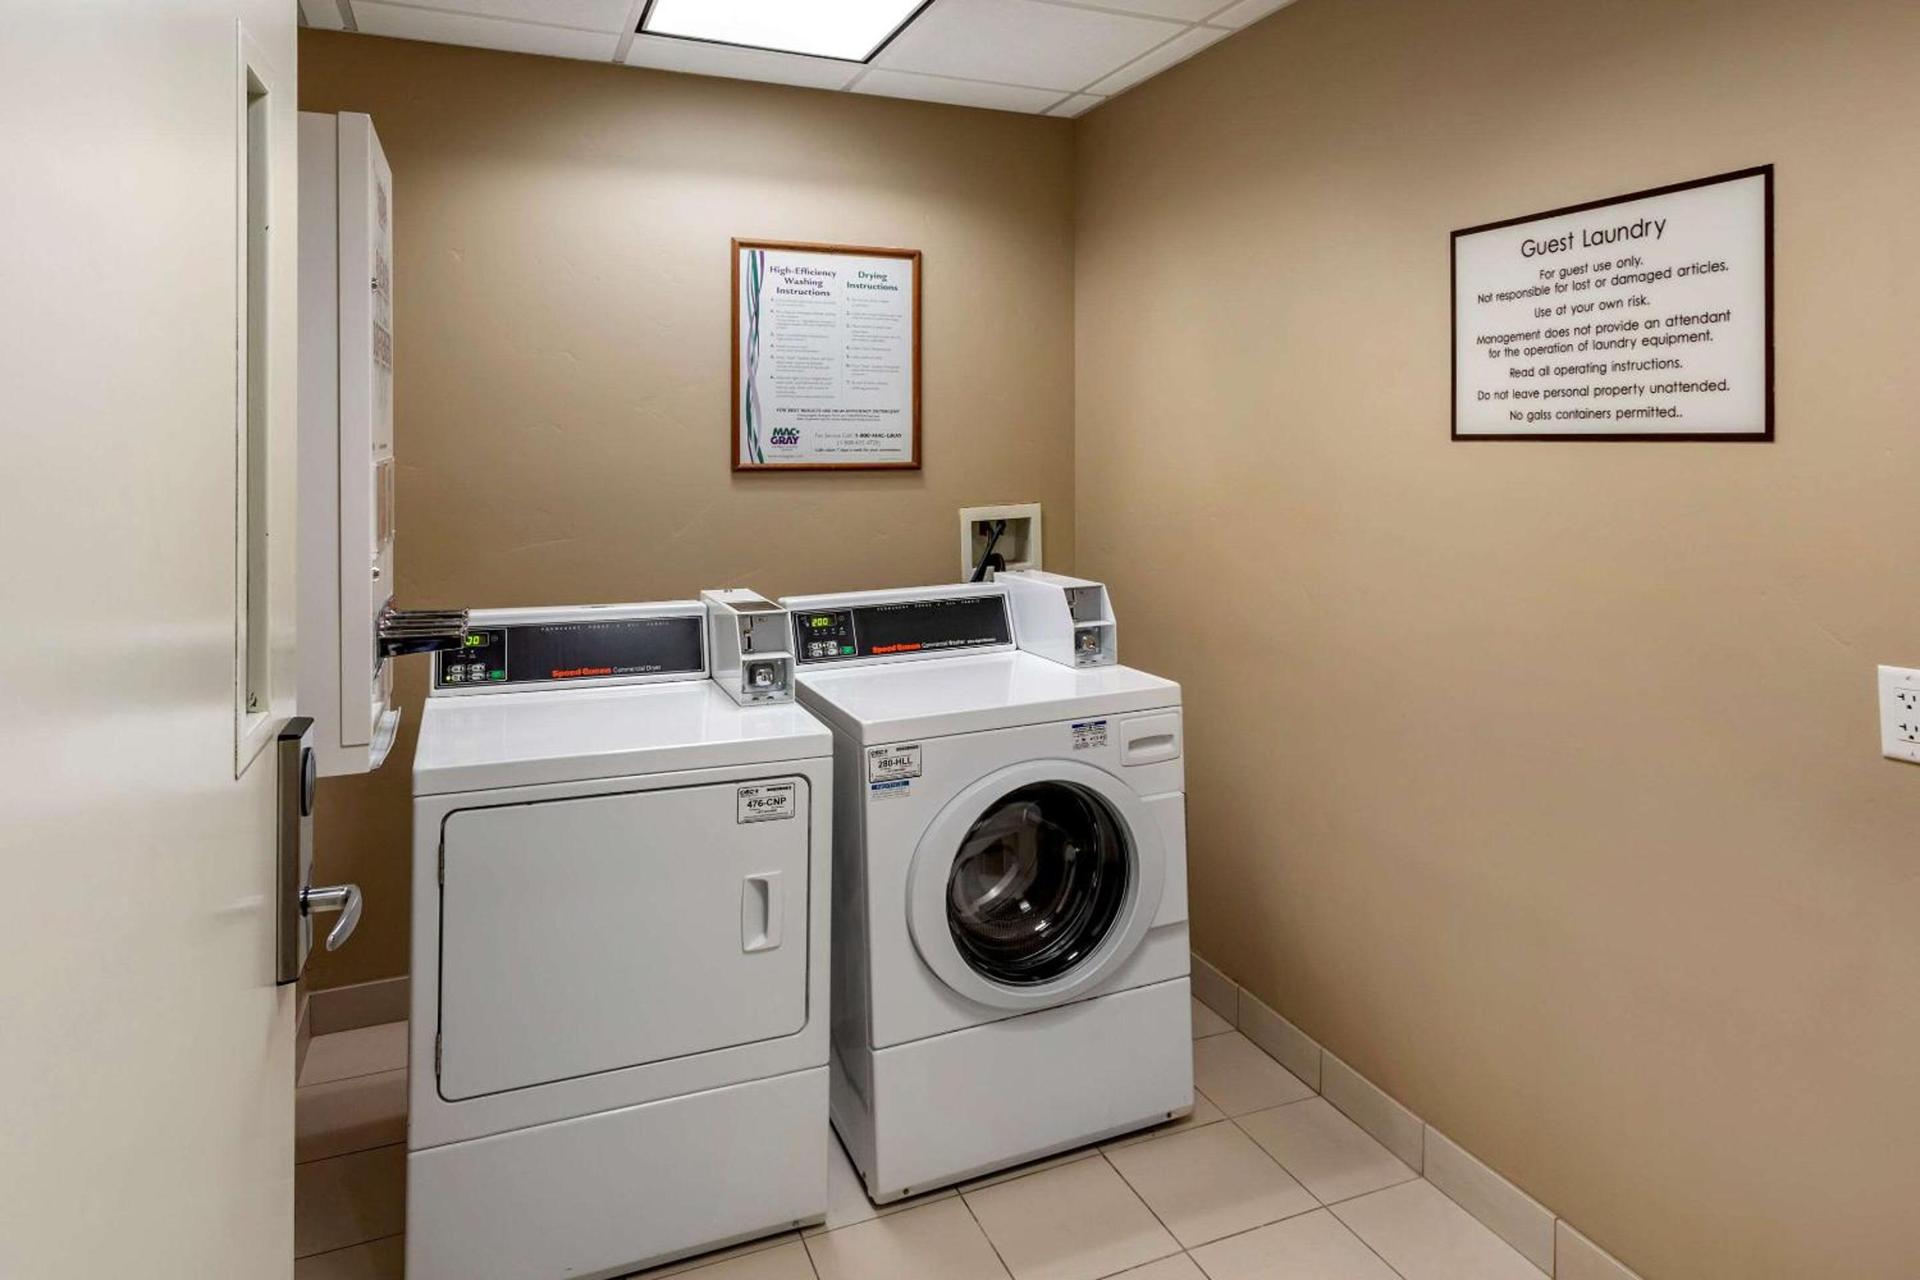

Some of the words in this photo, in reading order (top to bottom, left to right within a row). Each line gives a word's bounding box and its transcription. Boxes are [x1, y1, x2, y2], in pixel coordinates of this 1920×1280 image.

[1521, 232, 1574, 258] Guest
[1583, 218, 1666, 248] Laundry
[770, 266, 837, 278] High-Efficiency
[1539, 269, 1555, 280] For
[1559, 263, 1588, 280] guest
[1593, 261, 1612, 272] use
[1616, 256, 1643, 269] only.
[784, 277, 824, 288] Washing
[858, 271, 888, 282] Drying
[1478, 293, 1493, 304] Not
[1496, 286, 1551, 302] responsible
[1555, 282, 1568, 293] for
[1572, 279, 1591, 291] lost
[1594, 278, 1607, 288] or
[1611, 267, 1672, 286] damaged
[1677, 261, 1729, 277] articles.
[776, 287, 831, 296] Instructions
[846, 282, 898, 291] Instructions
[1534, 307, 1552, 318] Use
[1556, 304, 1567, 316] at
[1571, 303, 1595, 316] your
[1598, 299, 1624, 311] own
[1628, 294, 1650, 307] risk.
[1476, 330, 1541, 345] Management
[1544, 328, 1570, 338] does
[1573, 324, 1591, 336] not
[1595, 320, 1639, 336] provide
[1644, 319, 1660, 330] an
[1665, 309, 1731, 327] attendant
[1488, 348, 1501, 359] for
[1504, 347, 1520, 357] the
[1523, 343, 1574, 357] operation
[1578, 340, 1588, 352] of
[1593, 337, 1637, 350] laundry
[1641, 329, 1713, 348] equipment.
[1509, 367, 1535, 378] Read
[1538, 365, 1550, 377] all
[1554, 362, 1607, 377] operating
[1612, 358, 1683, 372] instructions.
[1477, 390, 1491, 401] Do
[1494, 390, 1509, 400] not
[1512, 389, 1540, 399] leave
[1543, 385, 1589, 400] personal
[1593, 383, 1645, 398] property
[1649, 378, 1730, 394] unattended.
[1510, 411, 1523, 421] No
[1527, 409, 1552, 423] galss
[1555, 408, 1611, 420] containers
[1616, 405, 1683, 421] permitted..
[770, 436, 800, 445] GRAY
[811, 617, 829, 627] 200
[551, 667, 581, 678] Speed
[582, 666, 612, 676] Queen
[747, 797, 787, 808] 476-CNP
